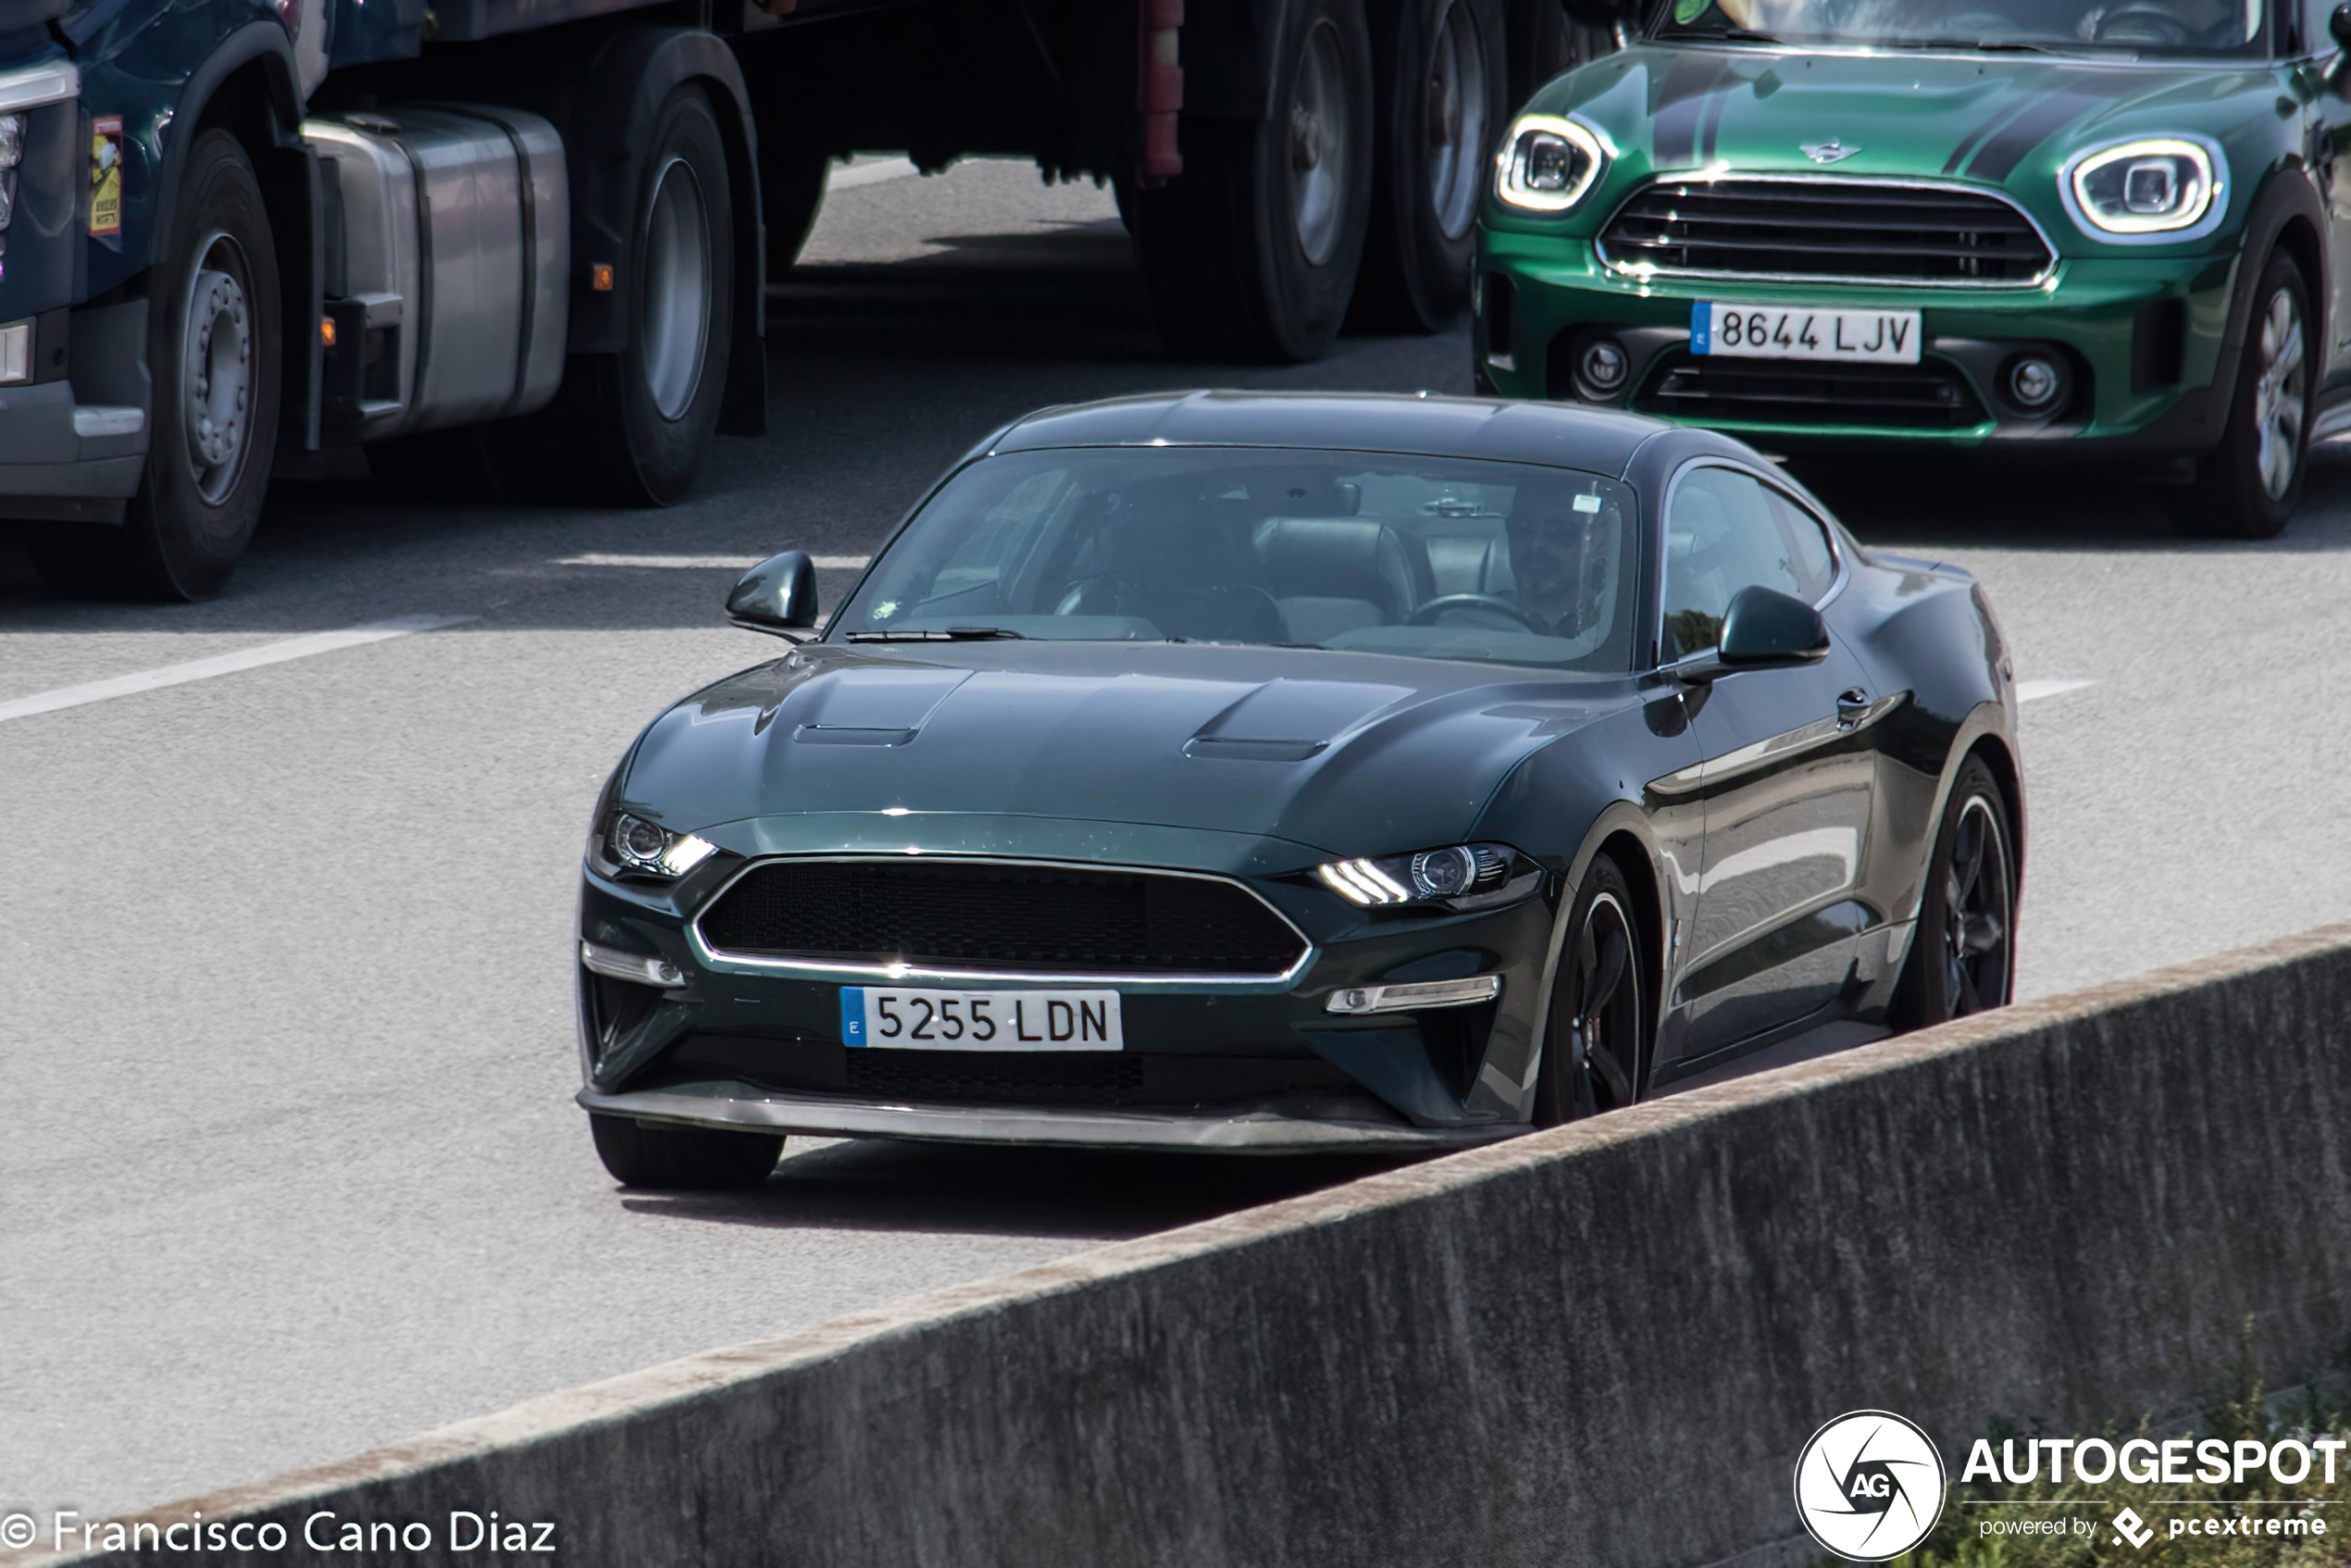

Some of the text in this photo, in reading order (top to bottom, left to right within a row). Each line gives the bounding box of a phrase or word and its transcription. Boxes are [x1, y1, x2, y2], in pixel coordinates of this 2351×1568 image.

[1722, 311, 1910, 354] 8644 LJV
[877, 996, 997, 1041] 5255
[1014, 1000, 1108, 1042] LDN
